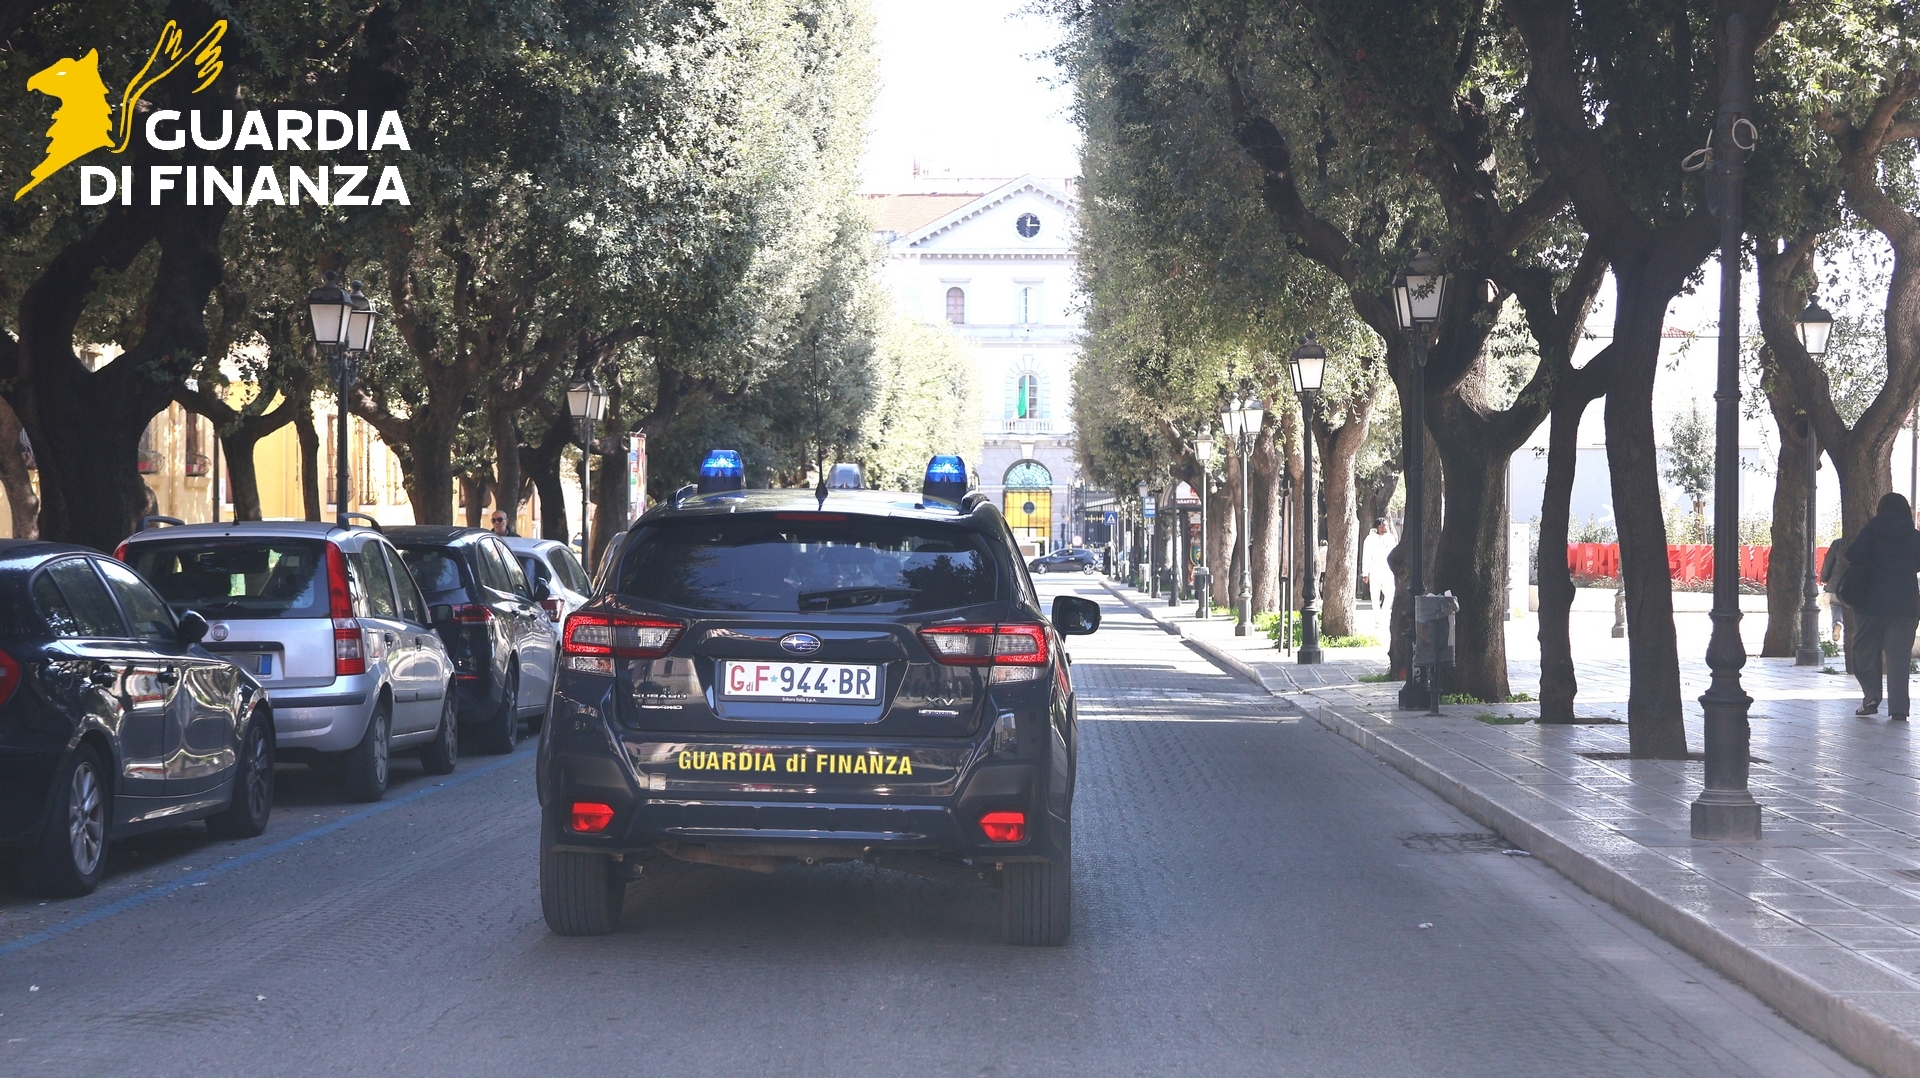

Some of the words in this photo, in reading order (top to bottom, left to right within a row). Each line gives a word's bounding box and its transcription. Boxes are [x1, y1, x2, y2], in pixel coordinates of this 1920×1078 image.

[678, 750, 777, 772] GUARDIA
[786, 754, 806, 773] di
[816, 754, 913, 776] FINANZA
